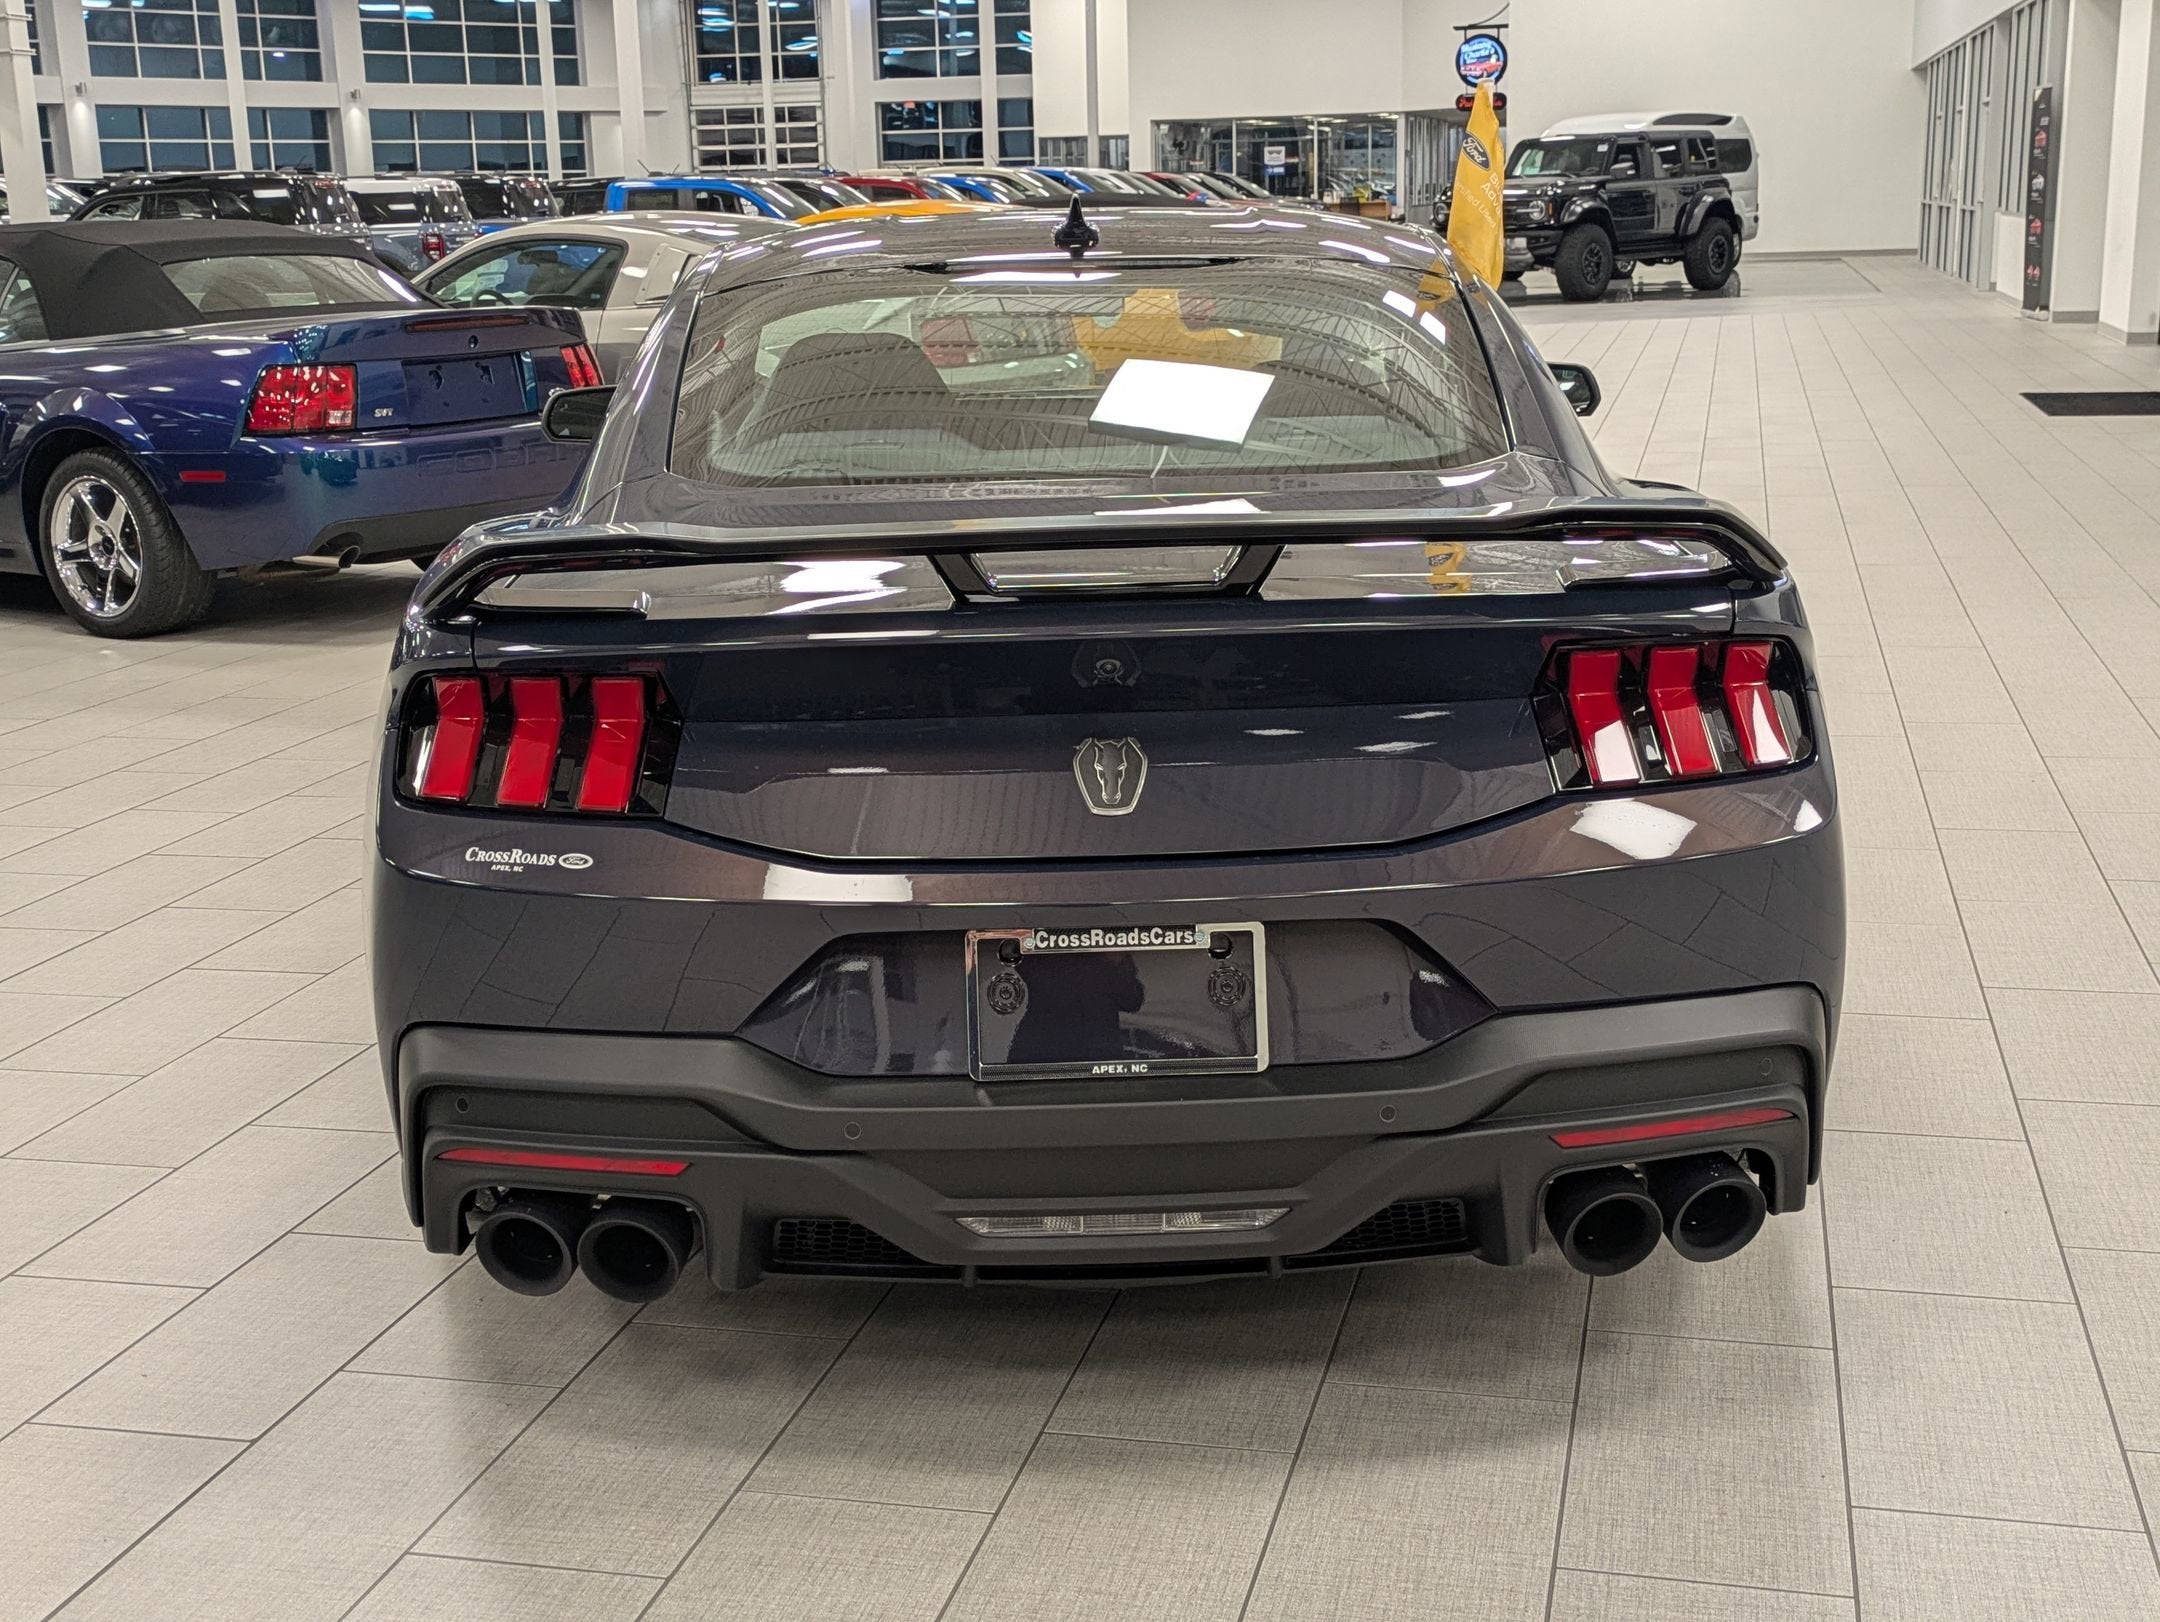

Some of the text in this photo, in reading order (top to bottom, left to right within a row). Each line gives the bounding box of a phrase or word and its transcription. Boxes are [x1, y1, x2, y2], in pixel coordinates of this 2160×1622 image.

[1463, 137, 1486, 163] Ford
[491, 864, 511, 872] APEX,
[1035, 927, 1193, 948] CrossRoadsCars
[1092, 1064, 1148, 1074] APEX, NC
